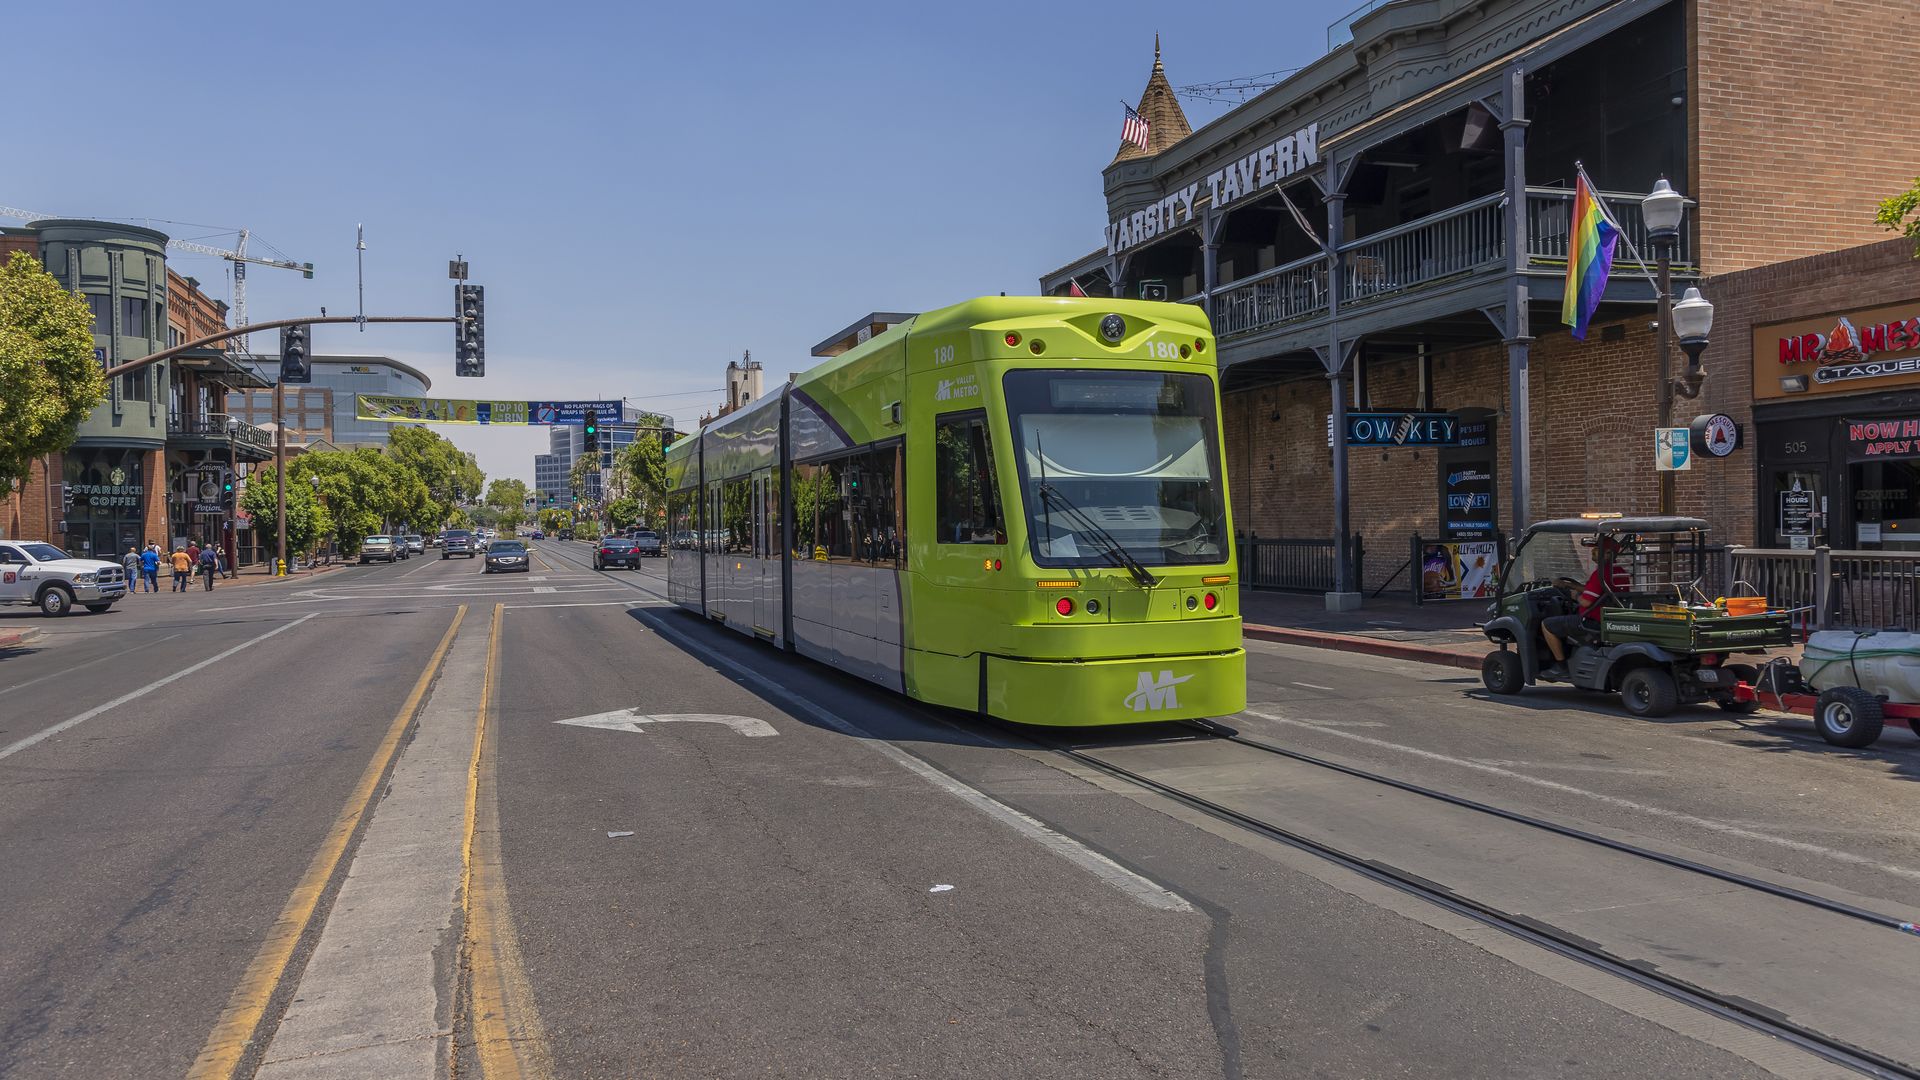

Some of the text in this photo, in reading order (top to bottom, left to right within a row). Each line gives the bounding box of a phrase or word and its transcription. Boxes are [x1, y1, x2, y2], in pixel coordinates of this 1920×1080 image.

[1105, 122, 1321, 257] VARSITY TAVERN
[1146, 341, 1178, 360] 180
[1779, 333, 1823, 364] MR
[934, 345, 955, 365] 180
[956, 375, 975, 385] VALLEY
[953, 384, 978, 399] METRO
[494, 403, 524, 413] TOP 10
[504, 413, 523, 422] BIN
[1409, 420, 1454, 440] KEY
[1850, 420, 1920, 440] NOW H
[1785, 442, 1807, 454] 505
[1865, 441, 1911, 454] APPLY
[73, 485, 143, 495] STARBUCKS
[1856, 489, 1907, 500] ESQUITE
[90, 496, 136, 506] COFFEE
[1449, 495, 1487, 506] LOW KEY
[1476, 543, 1496, 554] VALLEY
[1606, 621, 1641, 633] Kawasaki
[1726, 628, 1762, 640] Kawasaki
